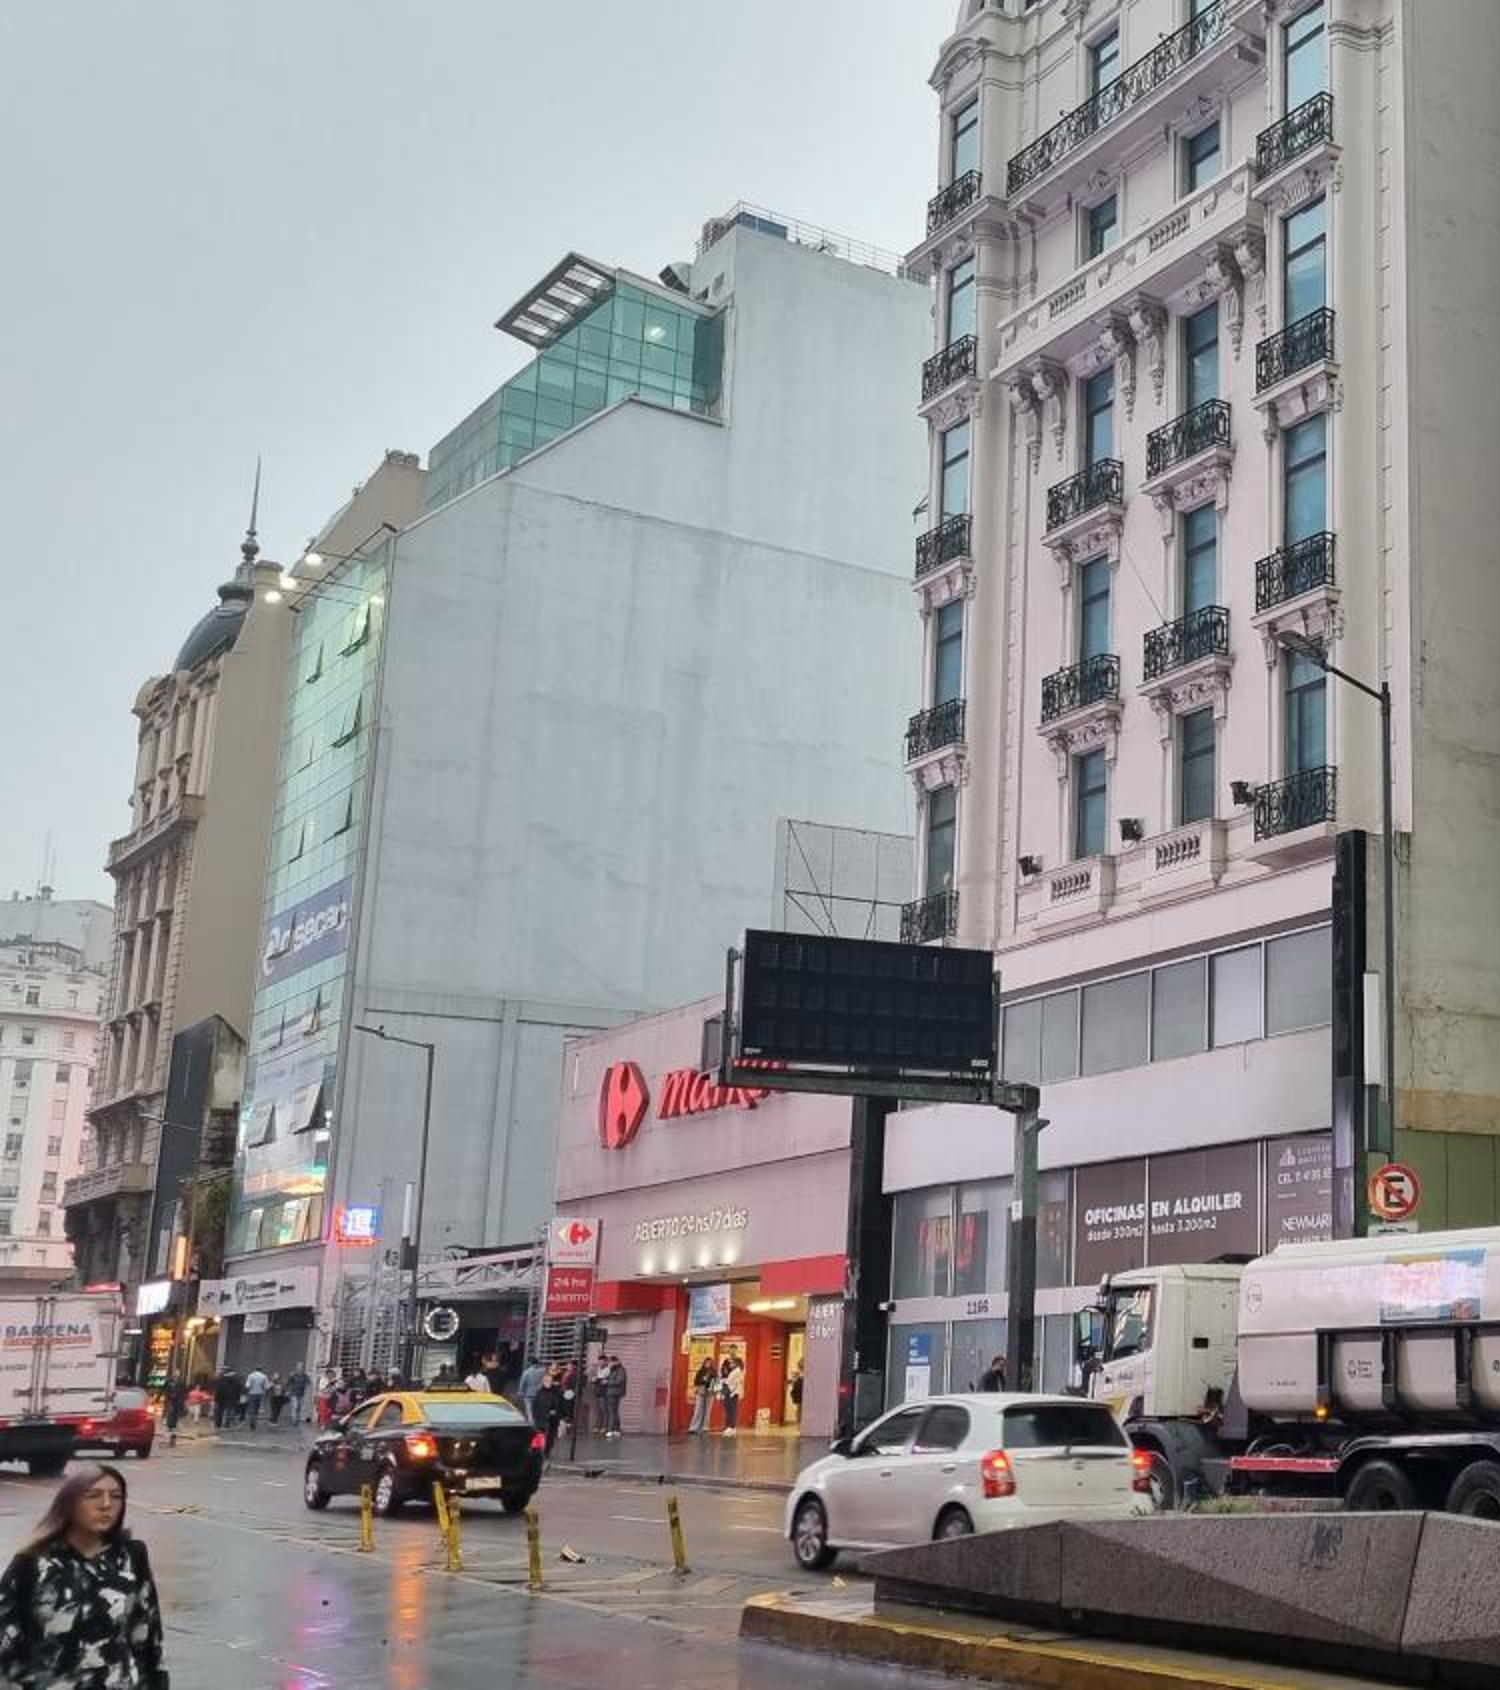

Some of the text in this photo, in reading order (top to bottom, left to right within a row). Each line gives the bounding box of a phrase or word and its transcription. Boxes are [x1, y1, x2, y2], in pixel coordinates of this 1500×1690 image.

[1084, 1191, 1242, 1225] OFICINAS EN ALQUILER
[633, 1216, 679, 1243] ABIERTO
[1151, 1222, 1175, 1235] hasta
[5, 1324, 91, 1337] BARCENA
